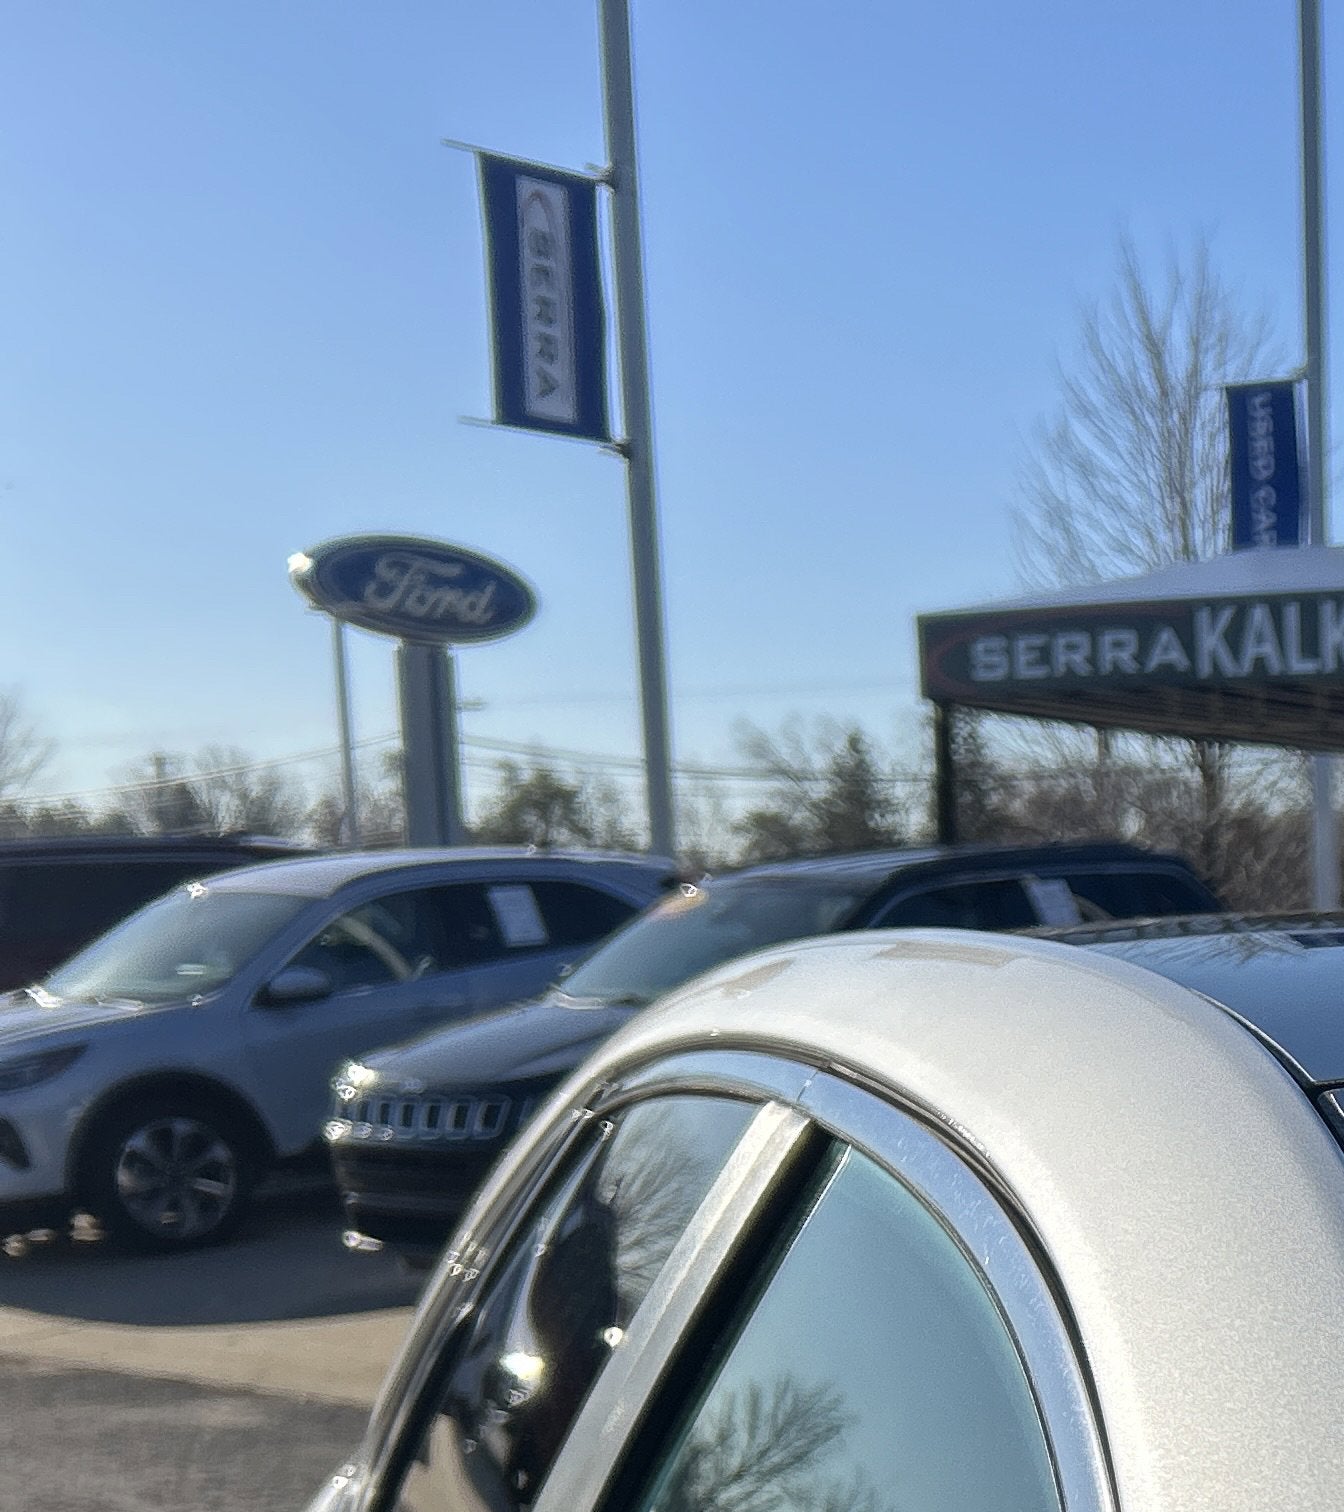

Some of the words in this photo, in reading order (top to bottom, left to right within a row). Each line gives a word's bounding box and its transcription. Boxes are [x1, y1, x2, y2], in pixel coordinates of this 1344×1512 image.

[528, 228, 560, 400] SERRA
[363, 551, 497, 625] Ford
[969, 625, 1193, 683] SERRA
